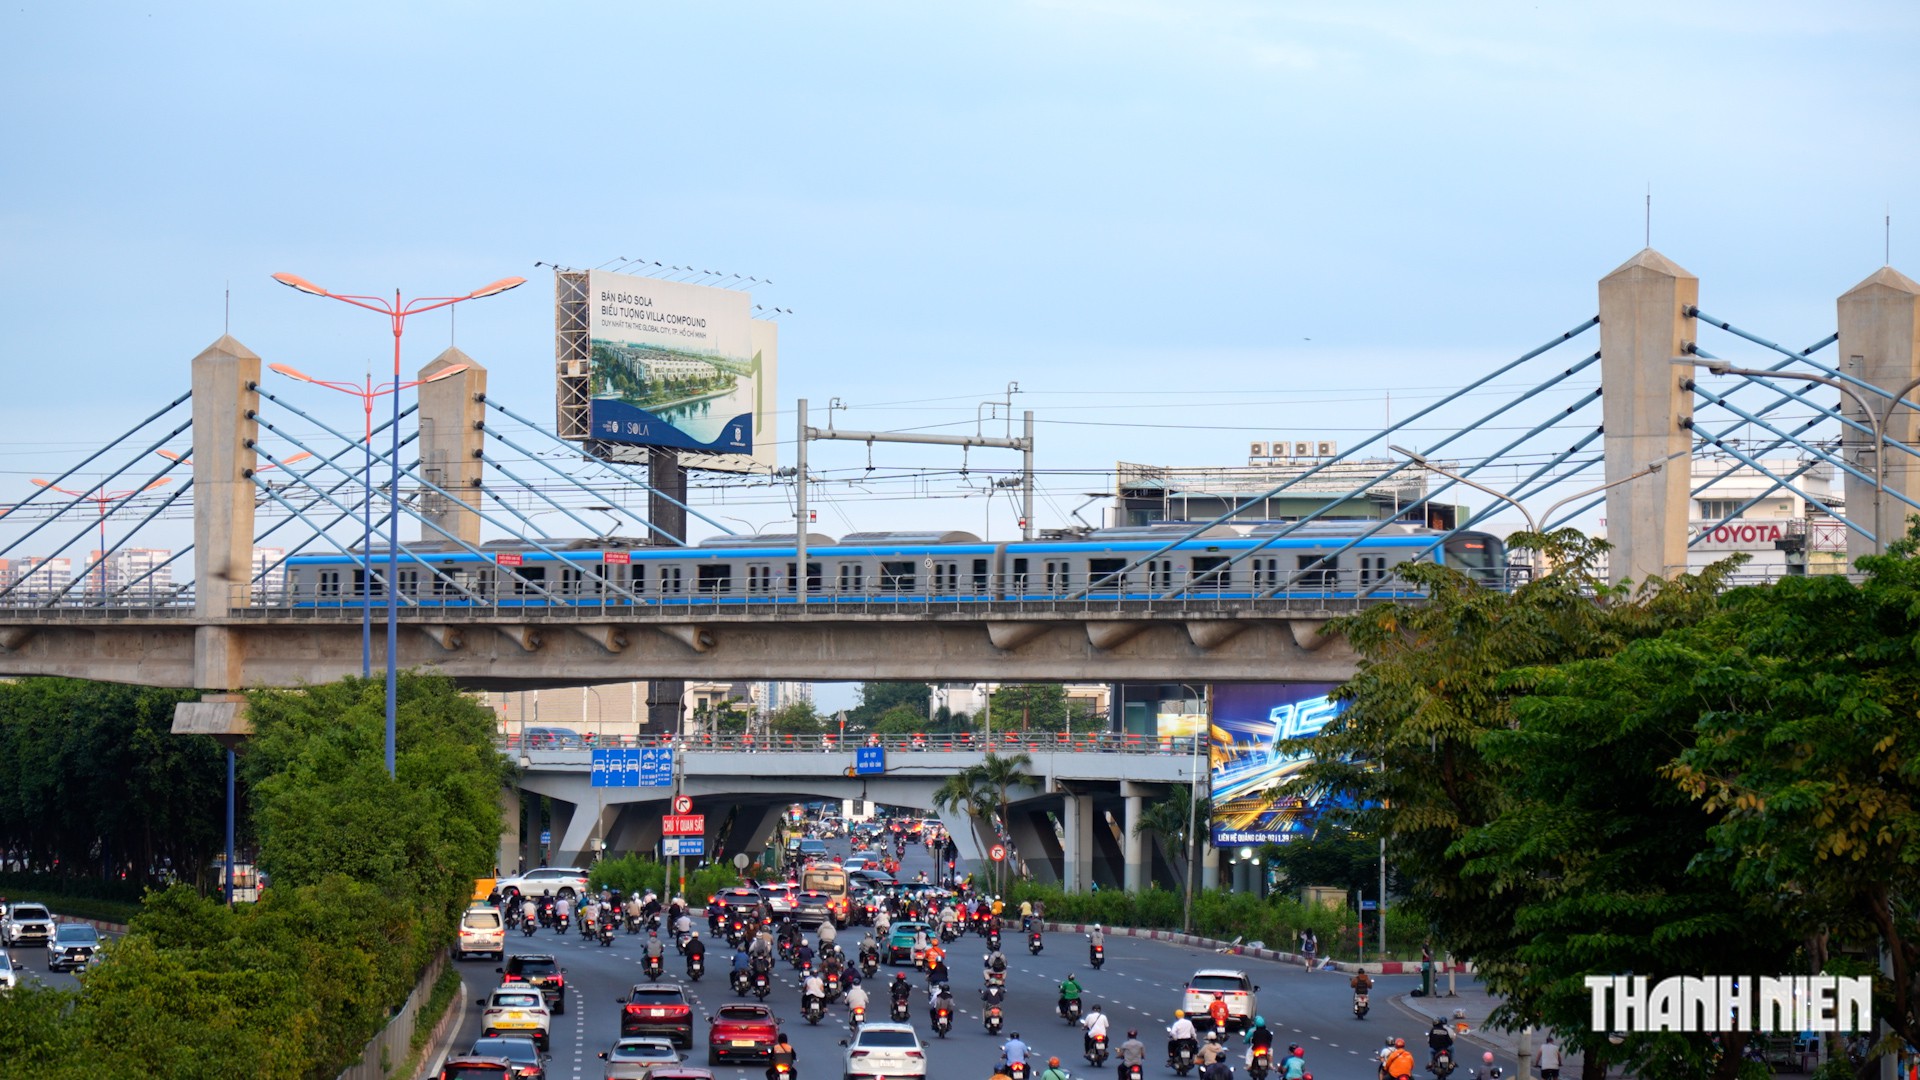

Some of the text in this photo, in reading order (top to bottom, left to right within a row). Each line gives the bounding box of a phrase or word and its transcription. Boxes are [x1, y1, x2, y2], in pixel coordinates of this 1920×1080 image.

[634, 295, 652, 306] SOLA
[646, 311, 665, 322] VILLA
[666, 314, 706, 328] COMPOUND
[632, 322, 642, 330] THE
[643, 324, 659, 333] GLOBAL
[627, 422, 649, 436] SOLA
[1702, 526, 1781, 542] TOYOTA
[664, 817, 674, 832] CHÚ
[680, 820, 694, 832] QUAN
[695, 816, 703, 831] SÁT
[1218, 833, 1229, 842] LIÊN
